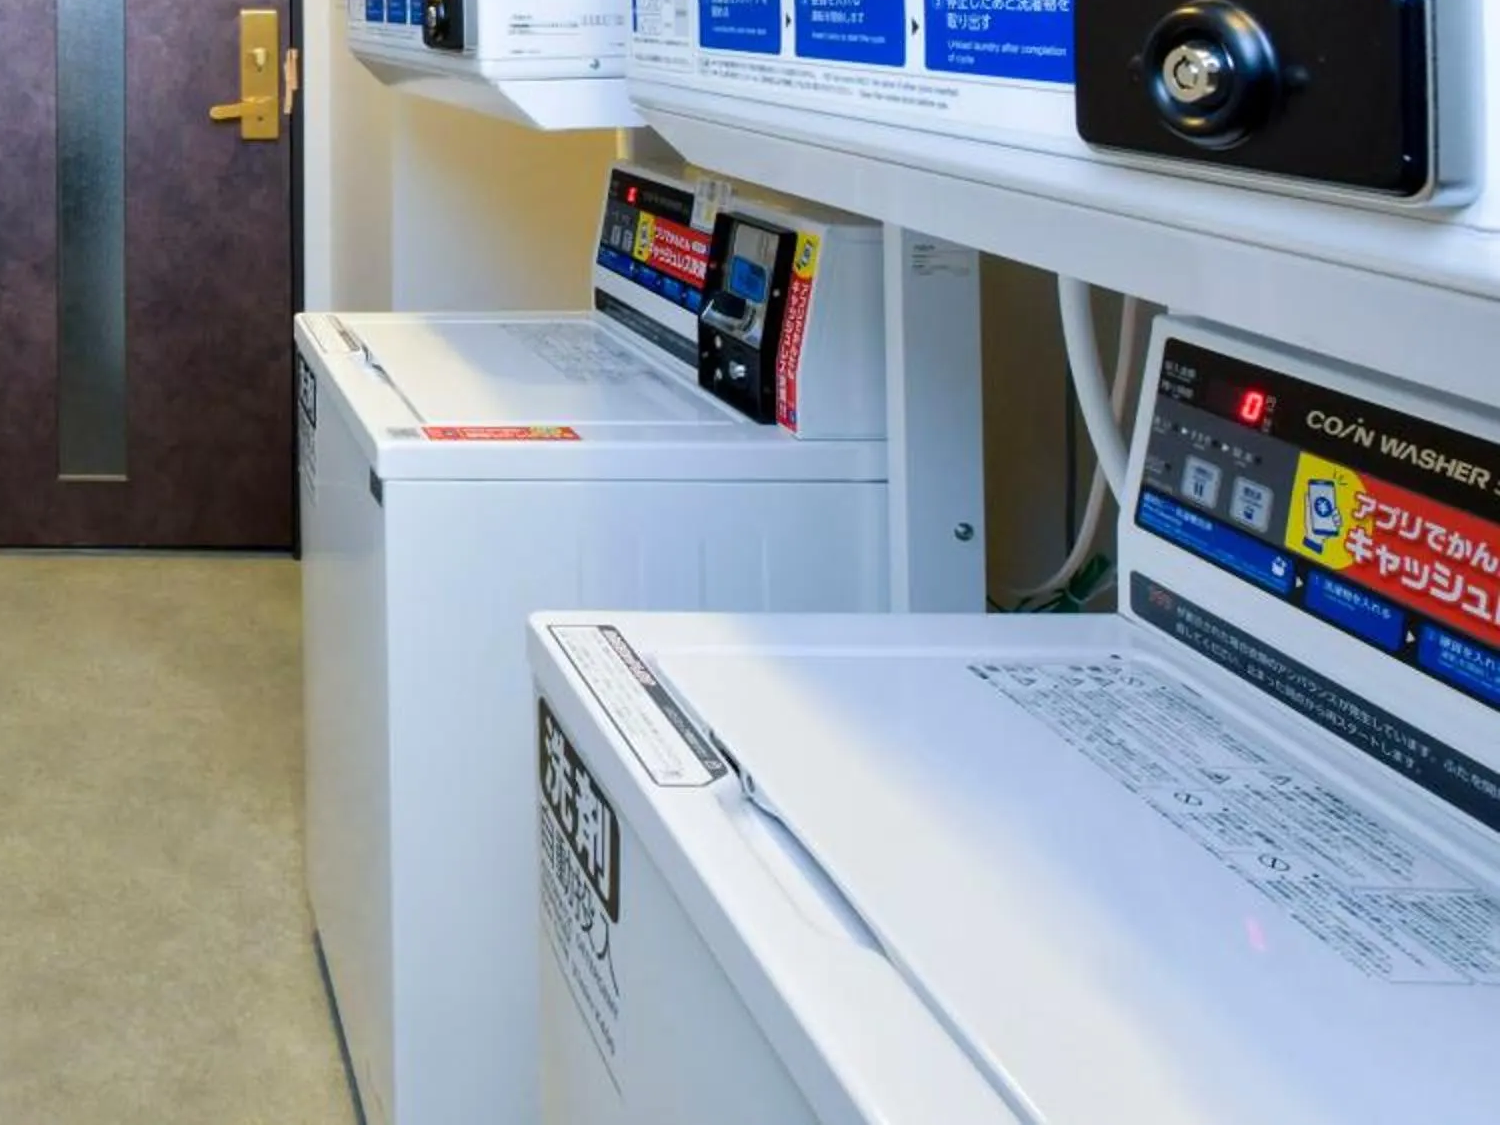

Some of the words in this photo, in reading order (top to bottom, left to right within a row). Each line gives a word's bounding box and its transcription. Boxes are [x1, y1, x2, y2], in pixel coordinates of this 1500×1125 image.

[947, 13, 992, 31] 取り出す
[1241, 390, 1265, 422] 0
[1380, 434, 1492, 490] WASHER
[545, 715, 612, 902] 洗剤
